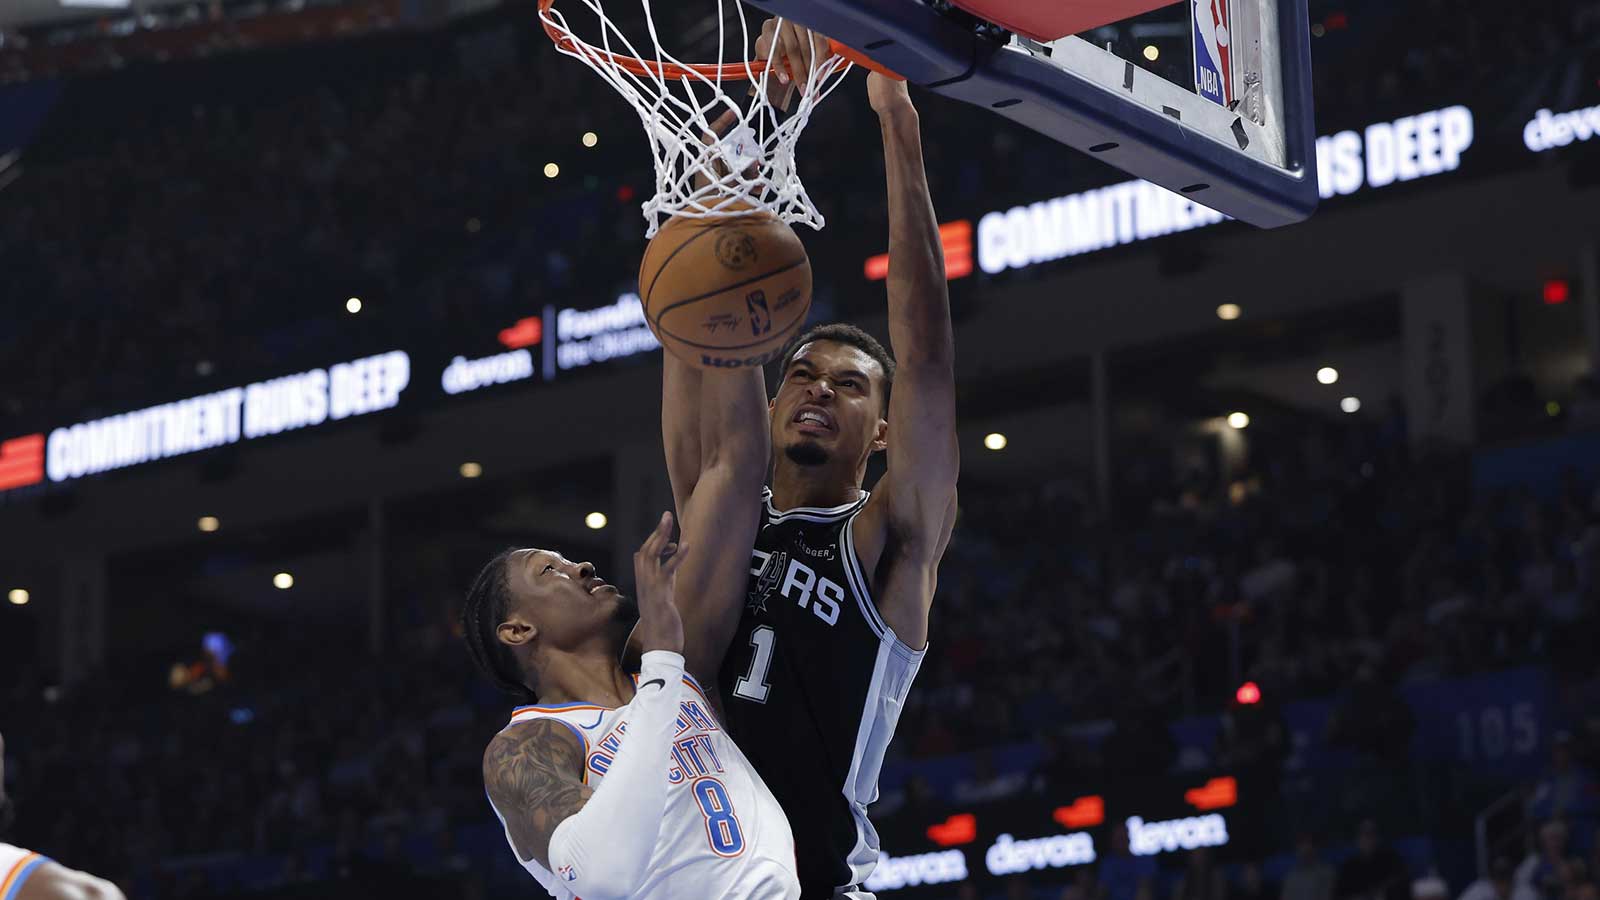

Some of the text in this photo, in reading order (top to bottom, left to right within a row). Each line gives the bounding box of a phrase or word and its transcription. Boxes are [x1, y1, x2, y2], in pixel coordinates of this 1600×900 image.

[1200, 66, 1219, 97] NBA
[1524, 105, 1600, 152] dev
[978, 178, 1235, 273] COMMITME
[1366, 105, 1473, 188] DEEP
[442, 349, 533, 394] devon
[47, 350, 410, 481] COMMITMENT RUNS DEEP
[733, 624, 776, 704] 1
[1456, 700, 1538, 760] 105
[691, 776, 745, 858] 8
[986, 831, 1096, 876] devon
